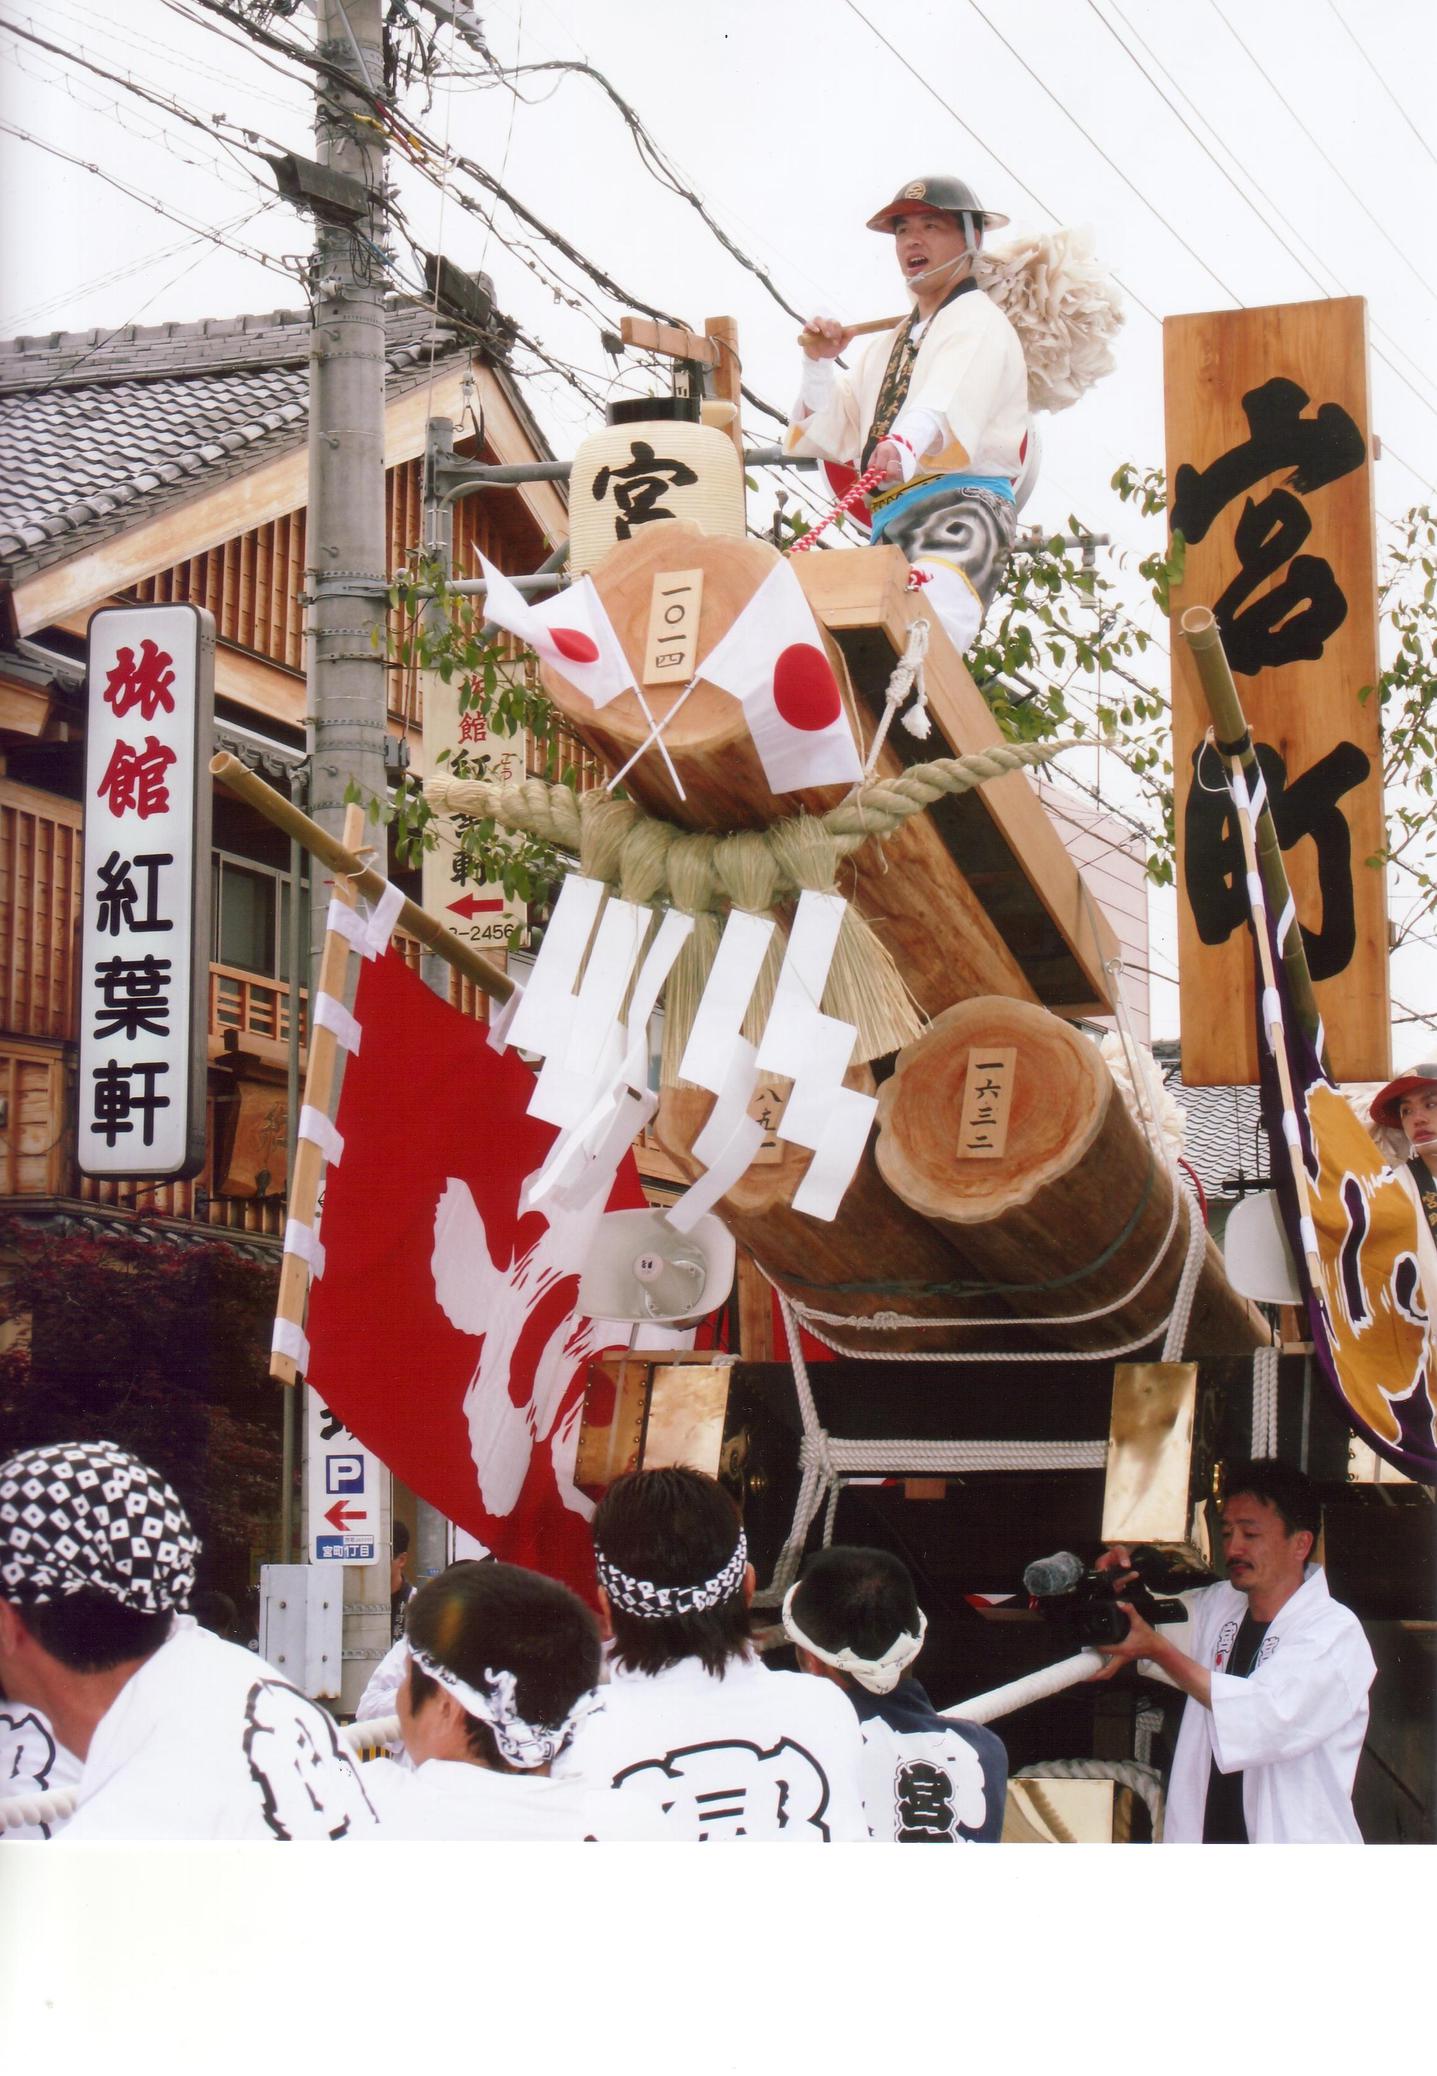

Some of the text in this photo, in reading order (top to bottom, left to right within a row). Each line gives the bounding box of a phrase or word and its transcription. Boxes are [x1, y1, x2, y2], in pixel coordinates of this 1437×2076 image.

[1170, 376, 1370, 982] 宮町
[90, 638, 178, 1147] 旅館紅葉軒
[966, 1061, 1004, 1149] 一六三二
[329, 1457, 362, 1491] P
